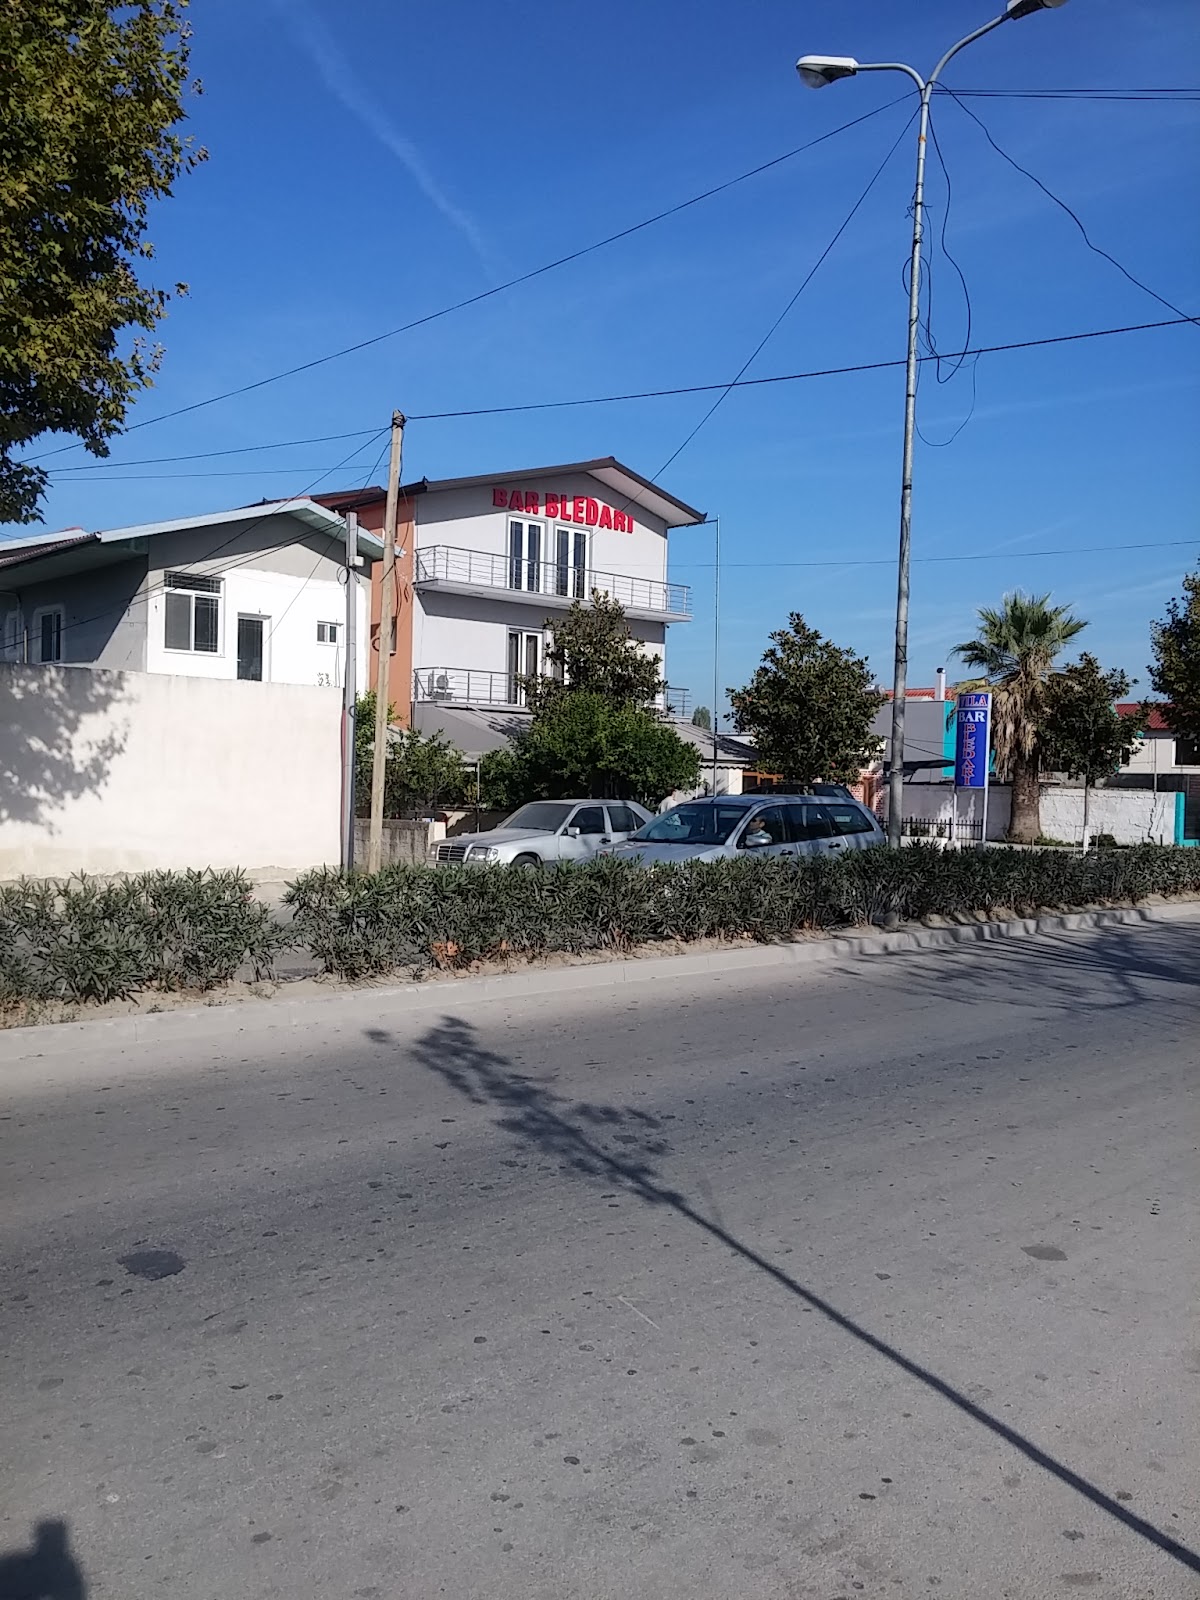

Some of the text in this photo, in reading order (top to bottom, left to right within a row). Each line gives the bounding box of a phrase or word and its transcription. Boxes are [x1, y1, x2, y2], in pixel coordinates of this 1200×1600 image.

[493, 488, 633, 533] BAR BLEDARI
[960, 695, 987, 707] VILA
[958, 711, 986, 722] BAR
[962, 723, 976, 785] BLEDARI
